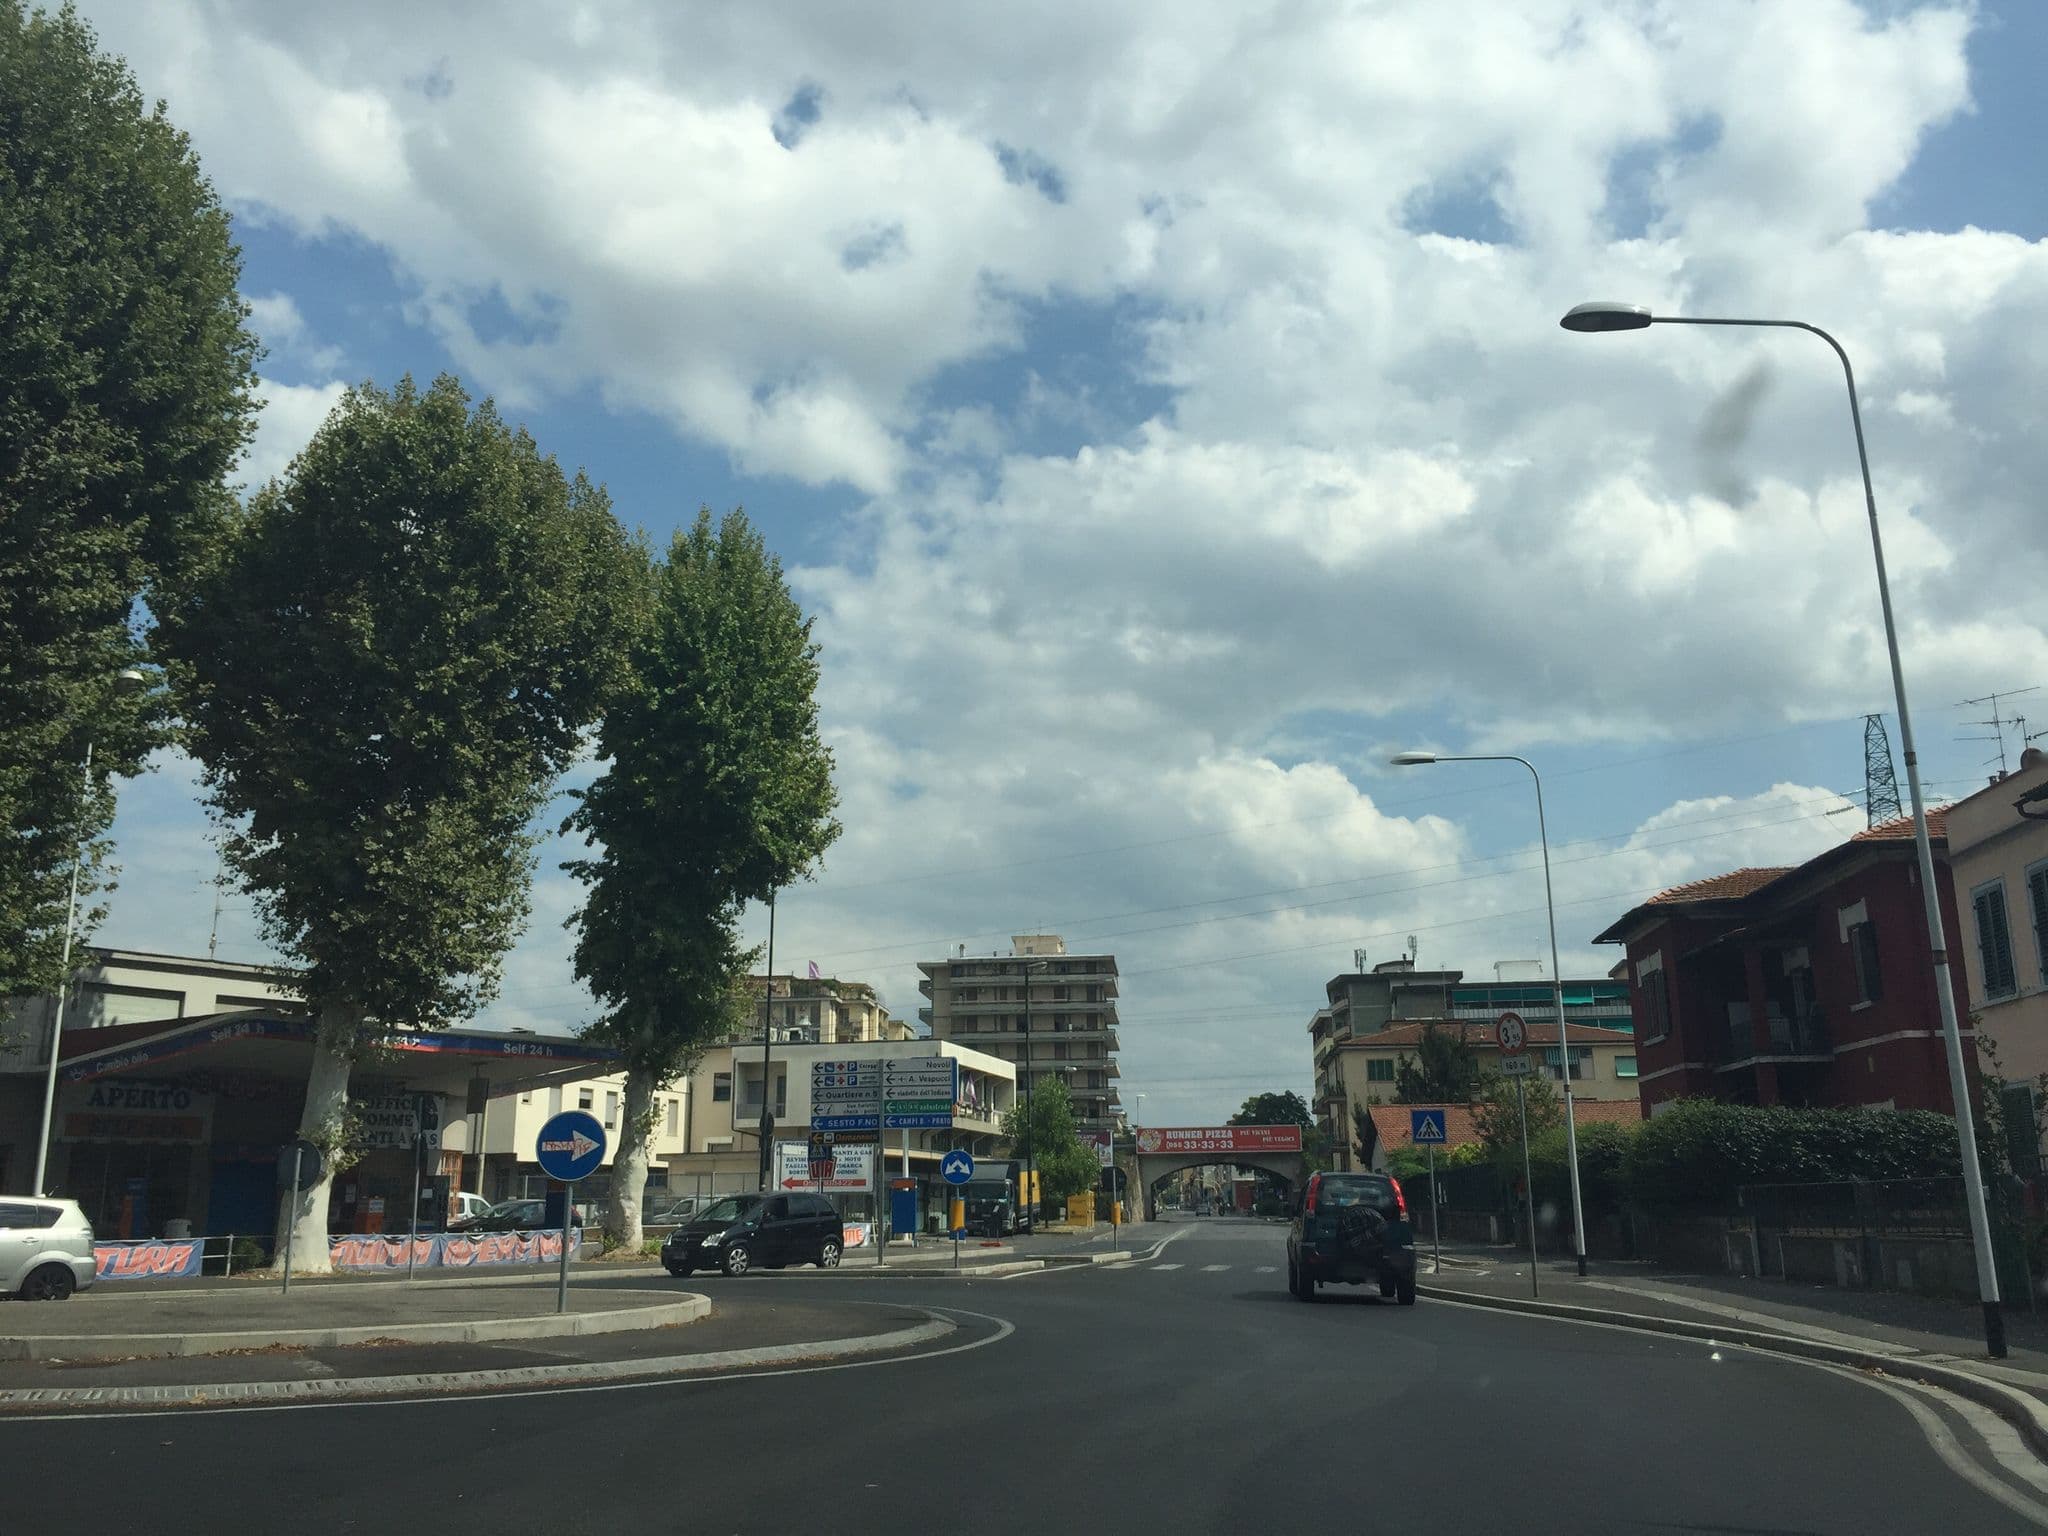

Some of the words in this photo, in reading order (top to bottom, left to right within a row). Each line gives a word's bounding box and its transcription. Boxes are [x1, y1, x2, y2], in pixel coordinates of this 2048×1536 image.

[210, 1026, 232, 1042] Self
[1503, 1027, 1510, 1044] 3
[503, 1042, 526, 1055] Self
[529, 1044, 544, 1056] 24
[546, 1046, 553, 1057] h
[96, 1058, 130, 1073] Cambio
[926, 1060, 951, 1069] Novoli
[918, 1074, 951, 1083] Vespucci
[87, 1087, 191, 1110] APERTO
[825, 1091, 863, 1099] Quartiere
[827, 1119, 856, 1127] SESTO
[857, 1118, 878, 1126] F.NO
[898, 1116, 918, 1125] CAMPI
[931, 1116, 951, 1124] PRATO
[1166, 1130, 1203, 1139] RUNNER
[1205, 1129, 1234, 1138] PIZZA
[328, 1239, 434, 1265] NUOVA
